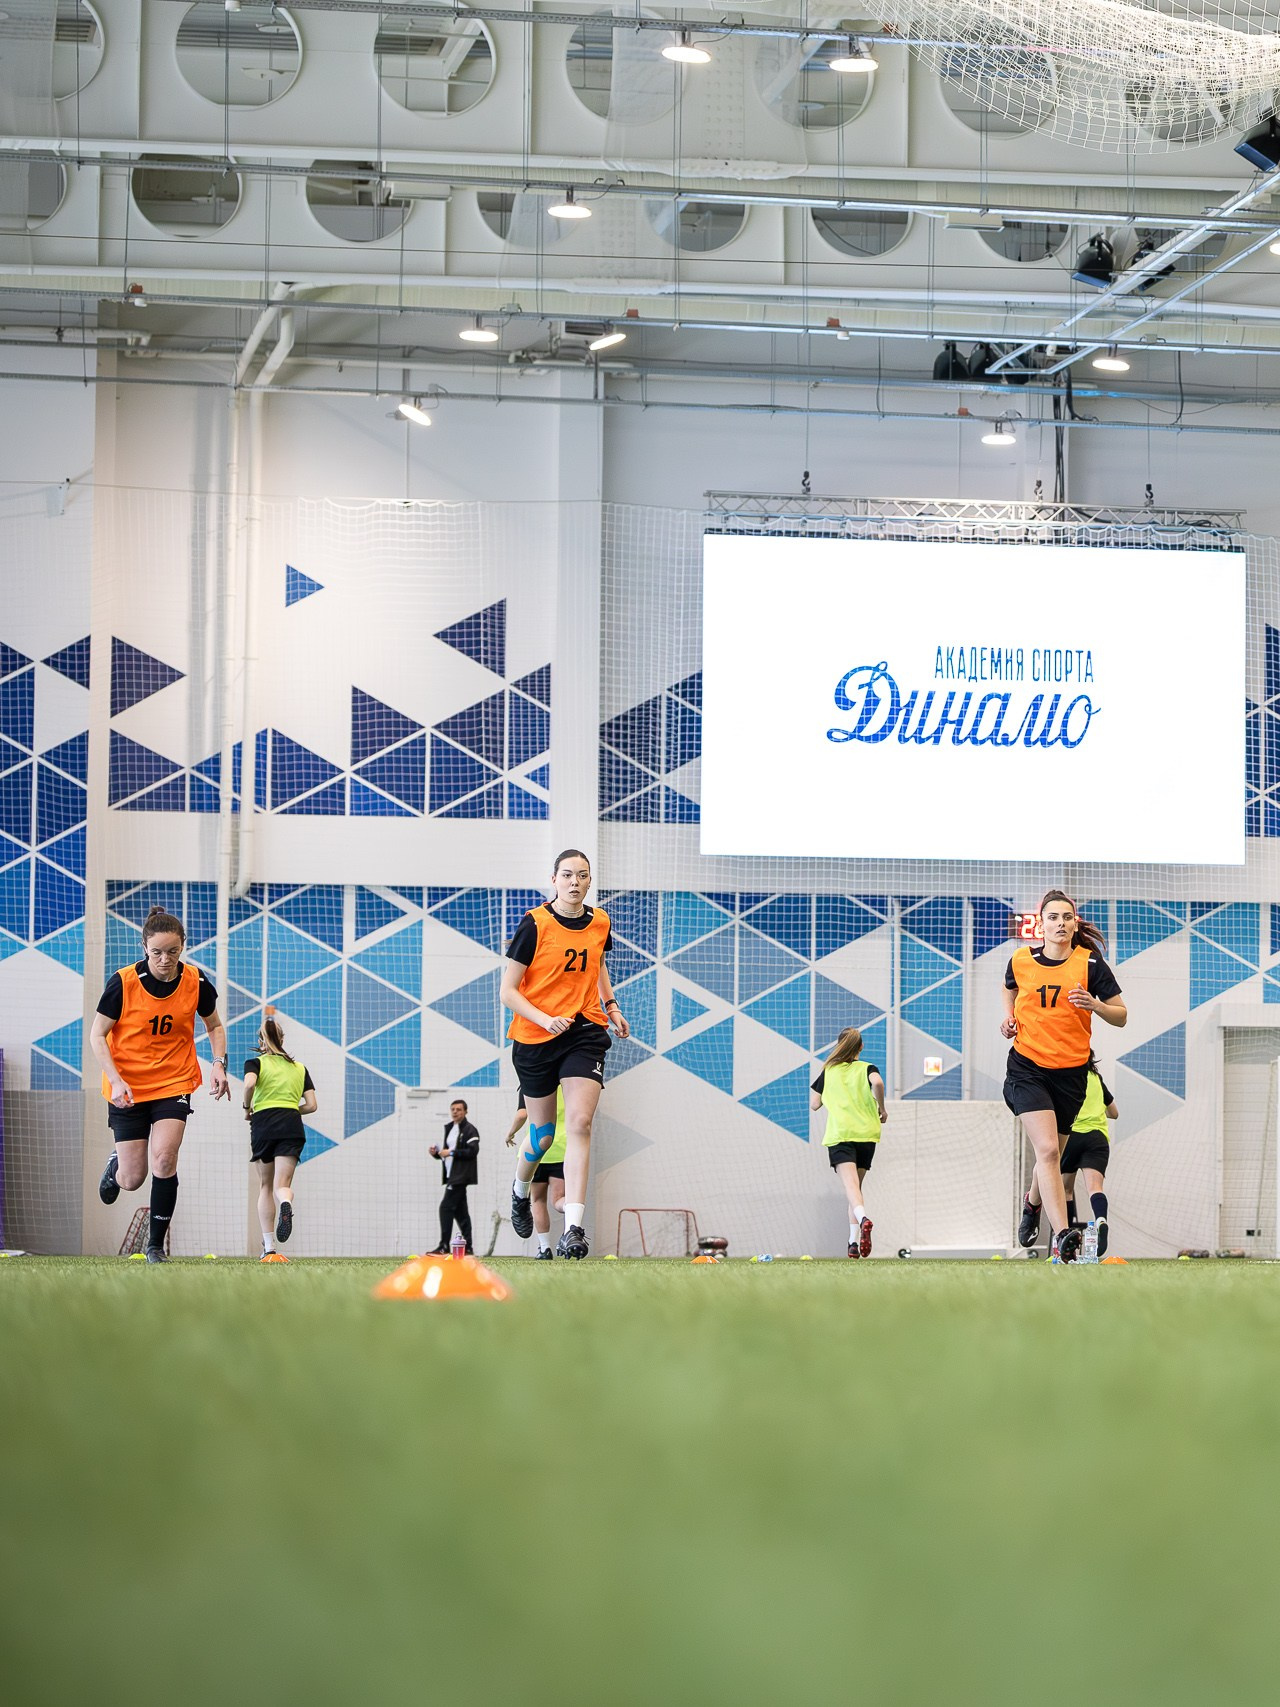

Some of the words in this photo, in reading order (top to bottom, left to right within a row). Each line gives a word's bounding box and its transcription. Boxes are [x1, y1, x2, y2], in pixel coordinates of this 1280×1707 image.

[935, 645, 1024, 683] АКАДЕМИЯ
[1032, 648, 1094, 683] СПОРТА
[826, 661, 1101, 749] Динамо
[564, 948, 588, 973] 21
[1036, 984, 1062, 1008] 17
[148, 1014, 174, 1036] 16
